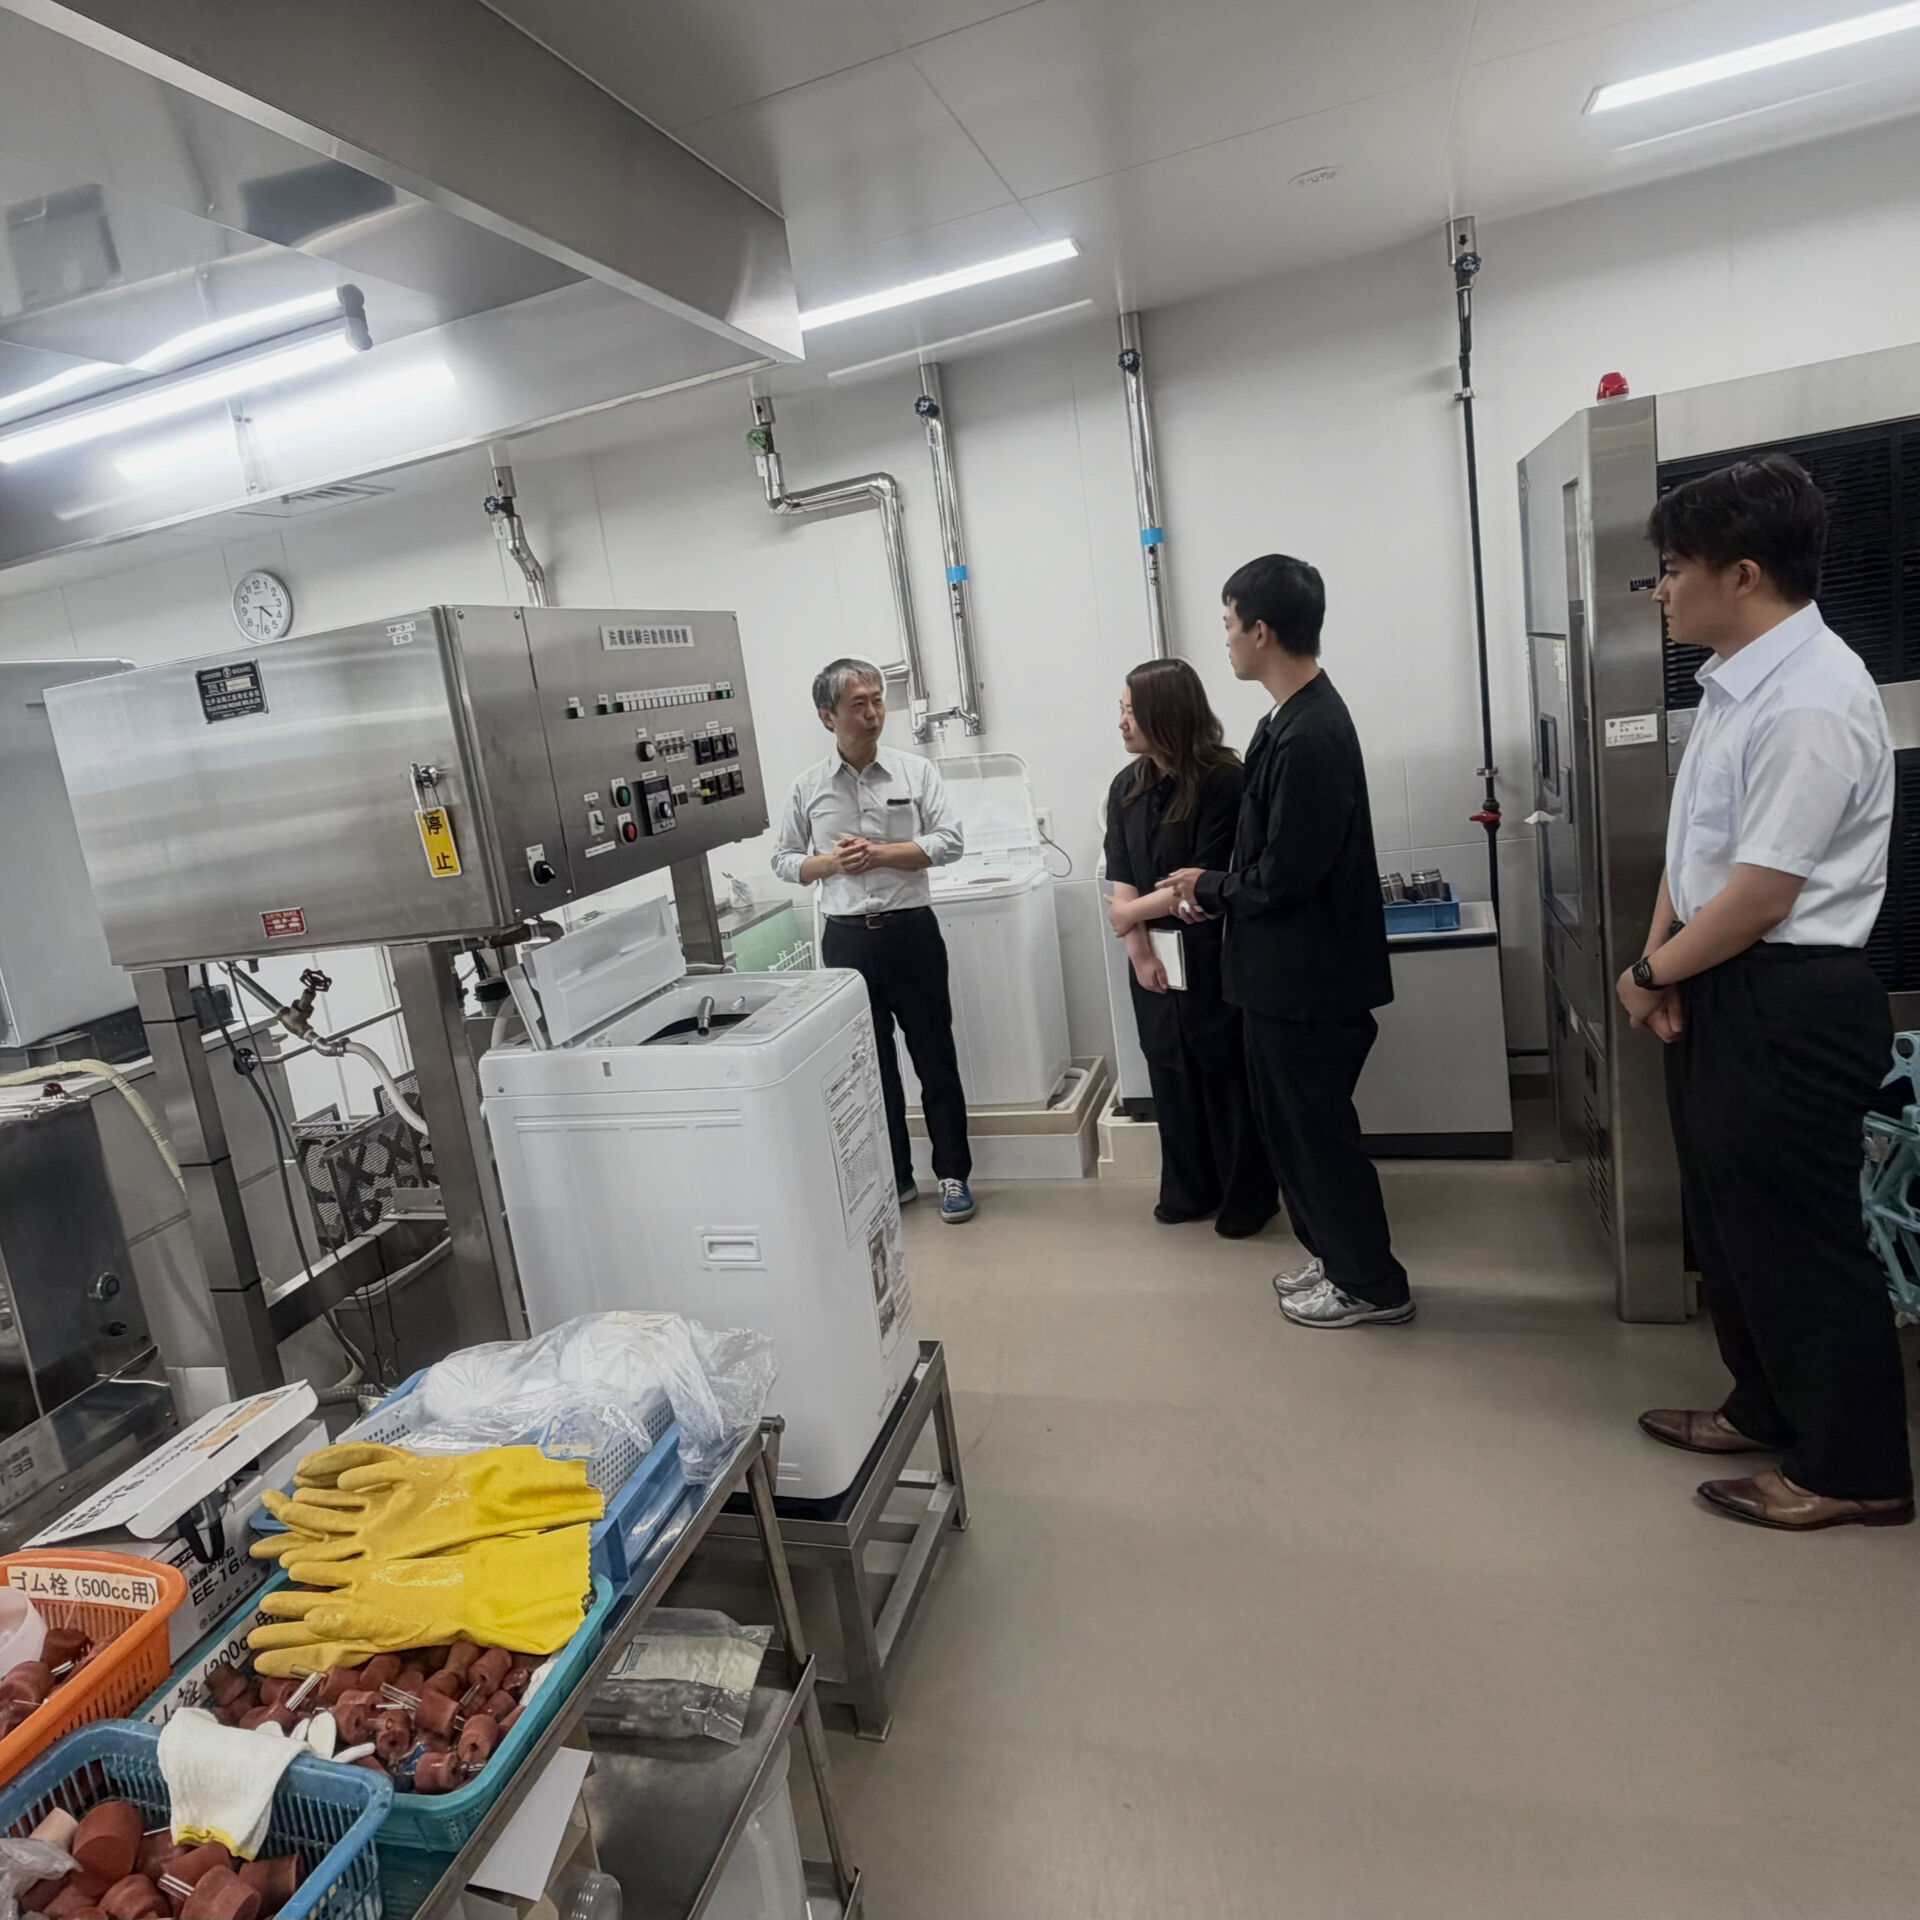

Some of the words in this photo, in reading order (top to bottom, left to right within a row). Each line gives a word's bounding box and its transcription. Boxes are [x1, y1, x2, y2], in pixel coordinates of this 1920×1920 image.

[252, 579, 261, 589] 12
[263, 581, 268, 589] 1
[245, 585, 252, 594] 11
[270, 586, 277, 596] 2
[240, 594, 249, 604] 10
[275, 598, 282, 607] 3
[241, 606, 248, 616] 9
[276, 610, 282, 618] 4
[247, 617, 253, 627] 8
[272, 620, 279, 629] 5
[254, 624, 260, 633] 7
[264, 625, 271, 634] 6
[424, 815, 453, 870] 停止
[192, 1557, 240, 1607] EE-16
